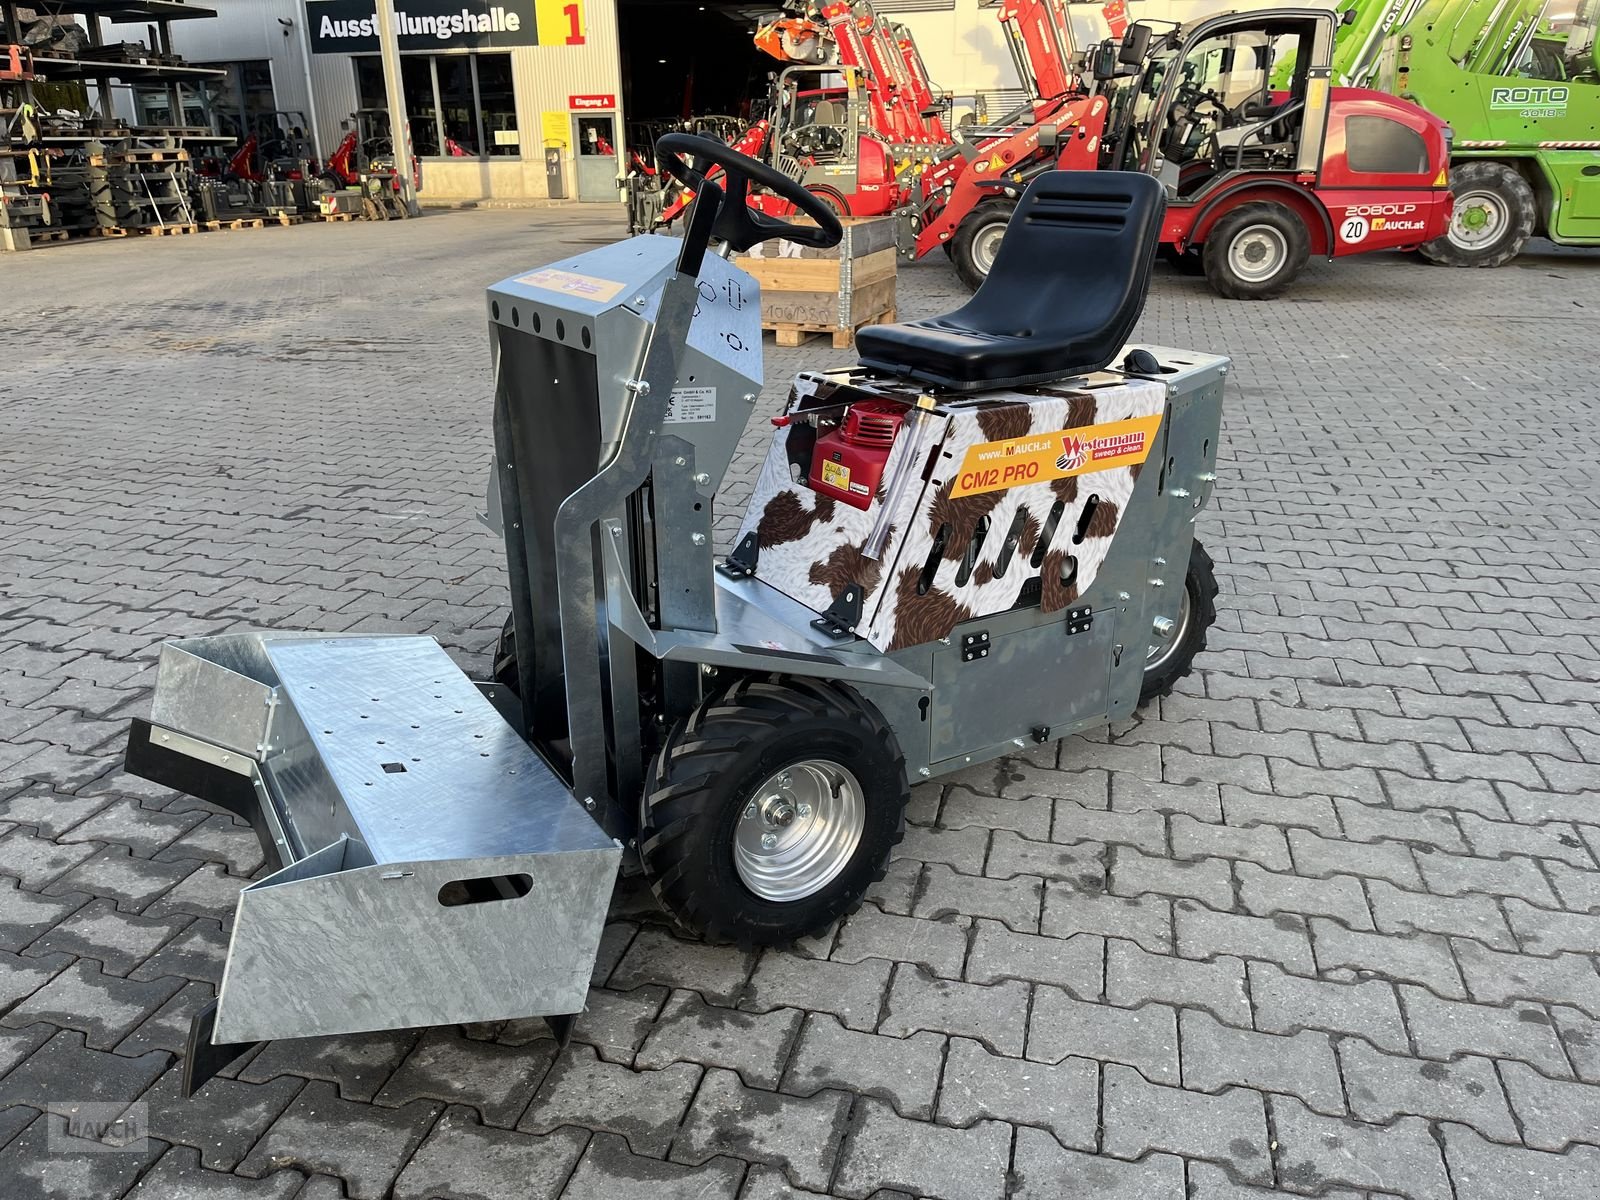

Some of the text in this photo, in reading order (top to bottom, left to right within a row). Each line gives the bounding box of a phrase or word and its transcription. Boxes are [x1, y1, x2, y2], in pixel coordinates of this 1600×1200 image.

[319, 4, 585, 45] Ausstllungshalle 1
[575, 97, 609, 107] Eingang A
[1491, 87, 1569, 103] ROTO
[1520, 109, 1556, 117] 40.18
[1345, 204, 1416, 216] 2080LP
[1346, 221, 1363, 238] 20
[1374, 220, 1425, 231] MAUCH.at
[978, 439, 1052, 462] www.MAUCH.at
[1062, 431, 1146, 456] Westermann
[1094, 449, 1116, 459] sweep
[960, 461, 1040, 491] CM2 PRO
